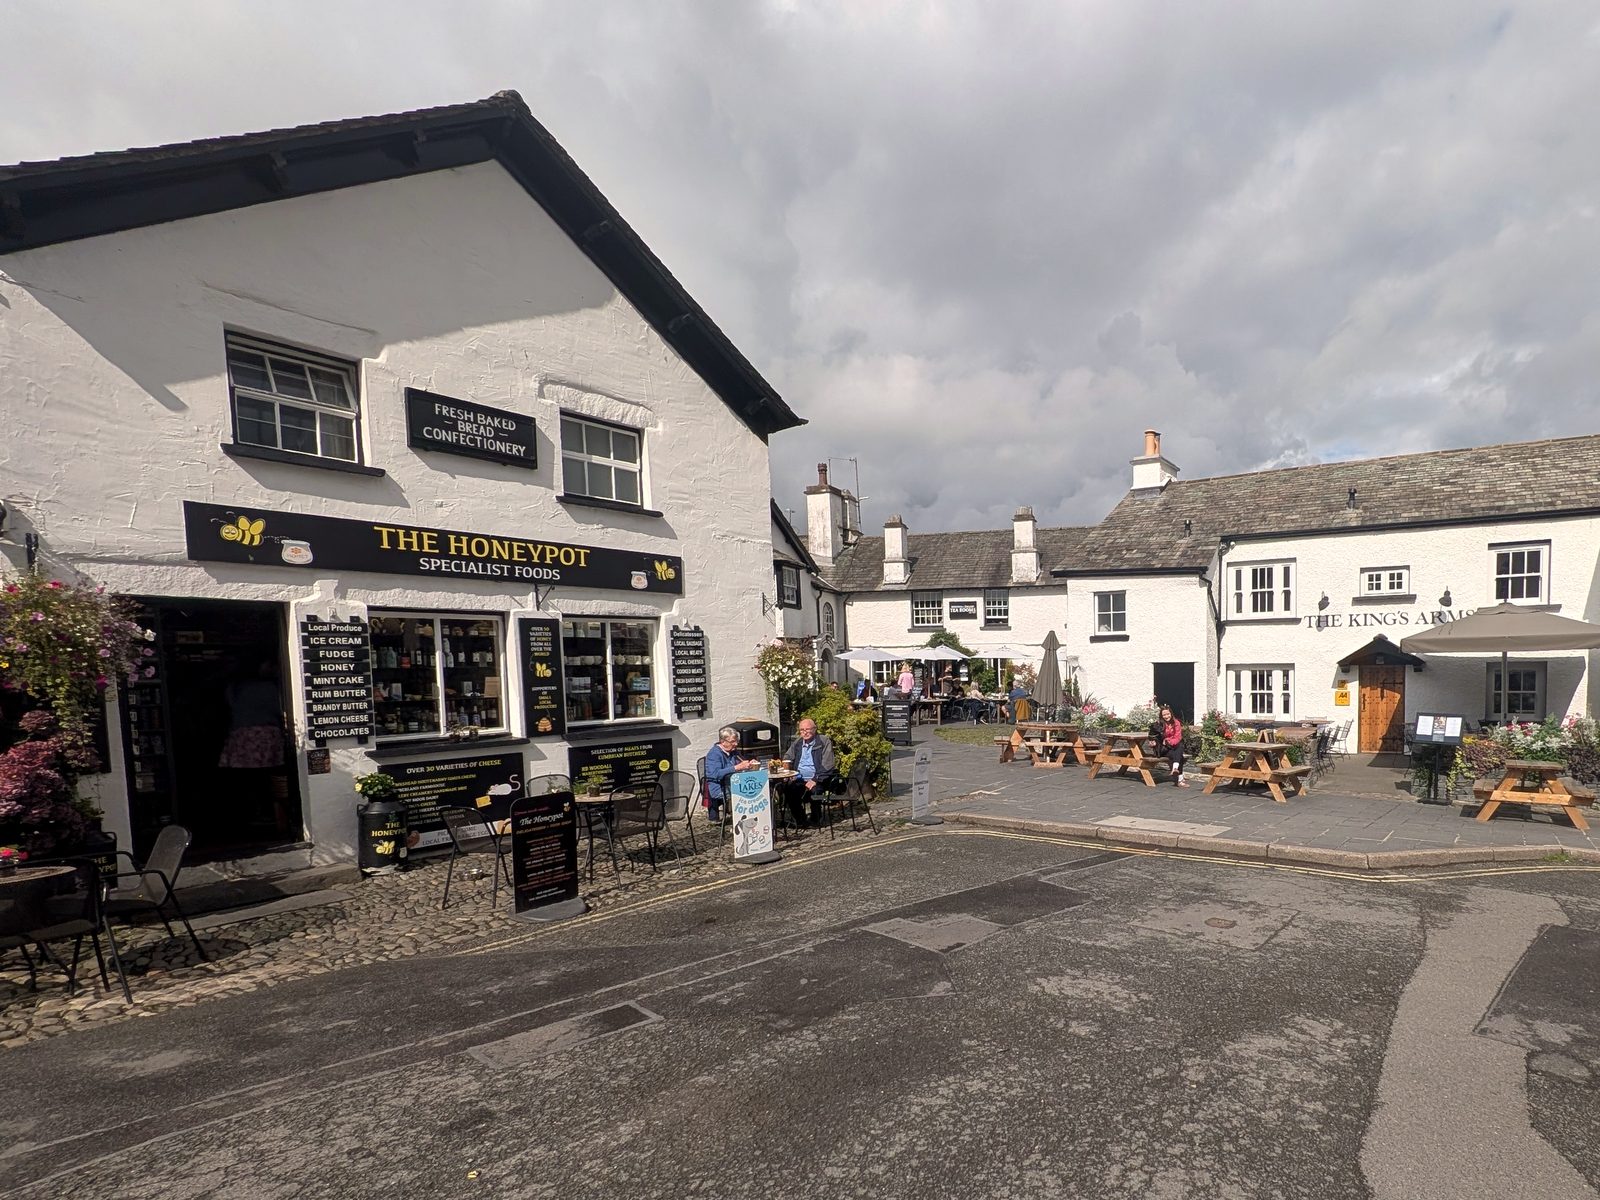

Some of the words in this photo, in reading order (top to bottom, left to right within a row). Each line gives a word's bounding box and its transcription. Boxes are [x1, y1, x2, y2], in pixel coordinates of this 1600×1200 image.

[434, 403, 474, 422] FRESH
[477, 414, 516, 431] BAKED
[458, 421, 494, 438] BREAD
[423, 426, 526, 456] CONFECTIONERY
[374, 526, 439, 553] THE
[450, 534, 590, 567] HONEYPOT
[419, 557, 511, 577] SPECIALIST
[515, 566, 560, 580] FOODS
[1304, 614, 1343, 628] THE
[1348, 611, 1409, 627] KING'S
[332, 624, 362, 632] Produce
[313, 704, 340, 712] BRANDY
[342, 702, 368, 710] BUTTER
[314, 716, 339, 725] LEMON
[341, 715, 369, 724] CHEESE
[315, 728, 370, 738] CHOCOLATES
[436, 762, 468, 771] VARIETIES
[739, 782, 762, 793] LAKES
[735, 802, 747, 814] for
[749, 799, 768, 814] dogs
[520, 817, 532, 826] The
[533, 812, 563, 823] Honeypot
